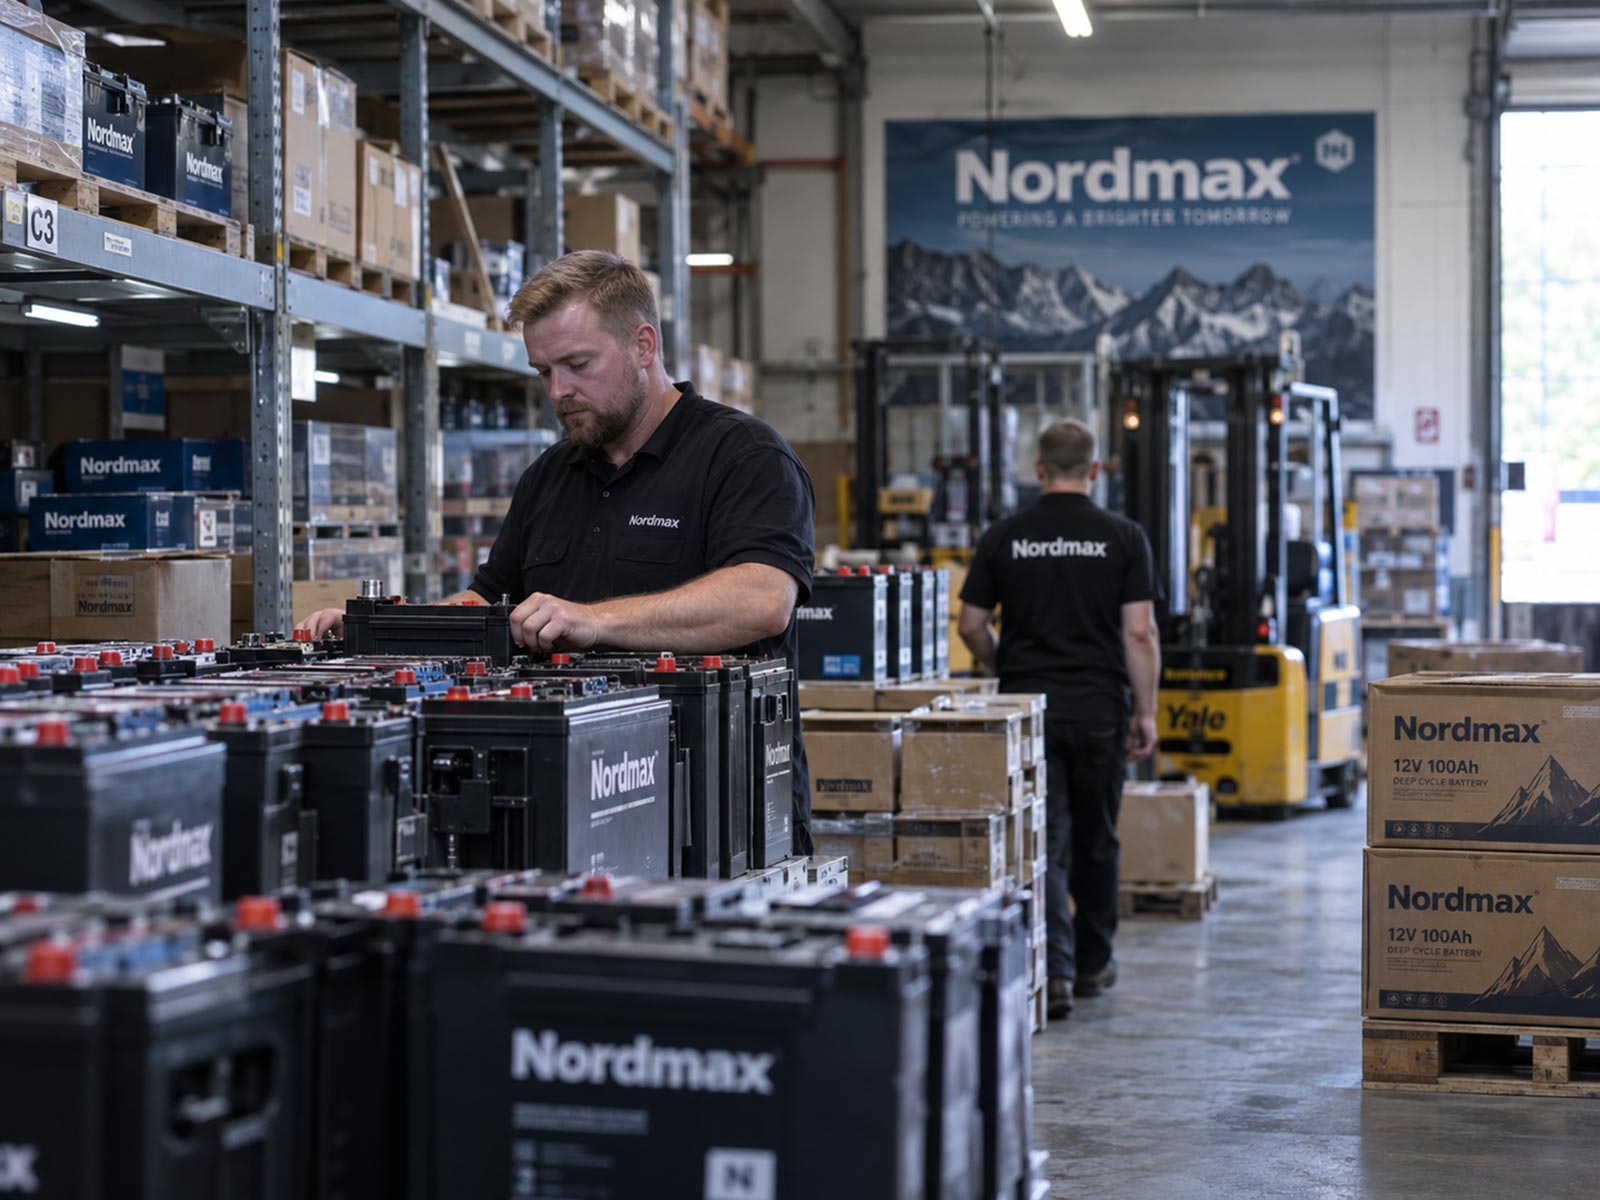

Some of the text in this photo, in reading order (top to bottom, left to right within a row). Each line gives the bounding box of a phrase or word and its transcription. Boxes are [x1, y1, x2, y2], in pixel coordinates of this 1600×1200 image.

[87, 117, 134, 154] Nordmax
[186, 152, 223, 184] Nordmax
[956, 148, 1291, 203] Nordmax
[31, 206, 54, 244] C3
[957, 206, 1291, 228] POWERING A BRIGHTER TOMORROW
[80, 456, 161, 474] Nordmax
[44, 511, 126, 528] Nordmax
[628, 514, 680, 528] Nordmax
[1012, 536, 1107, 559] Nordmax
[78, 600, 133, 613] Nordmax
[1394, 715, 1541, 743] Nordmax
[590, 751, 655, 800] Nordmax
[1393, 758, 1479, 774] 12V 100Ah
[1393, 777, 1488, 787] DEEP CYCLE BATTERY
[1388, 884, 1533, 914] Nordmax
[1388, 928, 1472, 944] 12V 100Ah
[1387, 946, 1482, 957] DEEP CYCLE BATTERY
[511, 1029, 773, 1095] Nordmax
